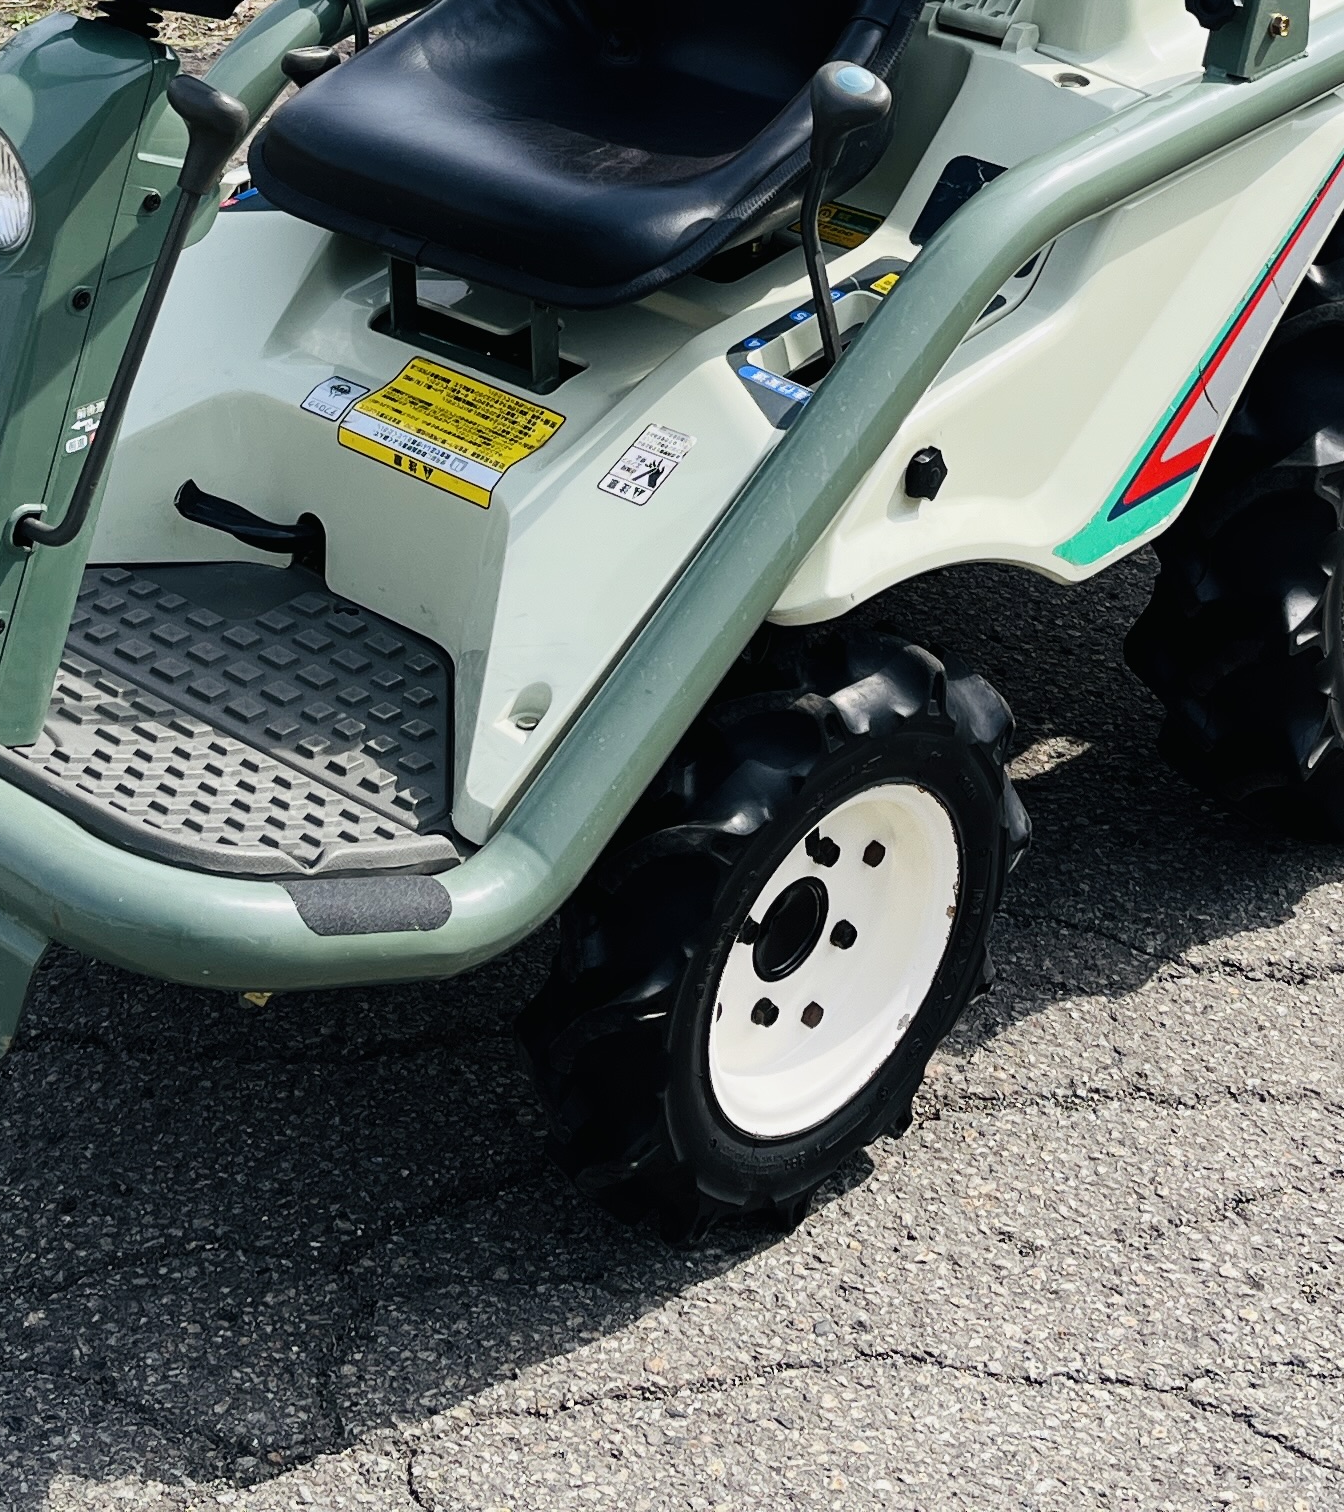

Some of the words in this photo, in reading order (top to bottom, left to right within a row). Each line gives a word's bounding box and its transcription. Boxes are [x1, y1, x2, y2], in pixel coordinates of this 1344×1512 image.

[795, 311, 809, 322] 5
[748, 339, 761, 349] 4
[607, 477, 632, 494] 注意
